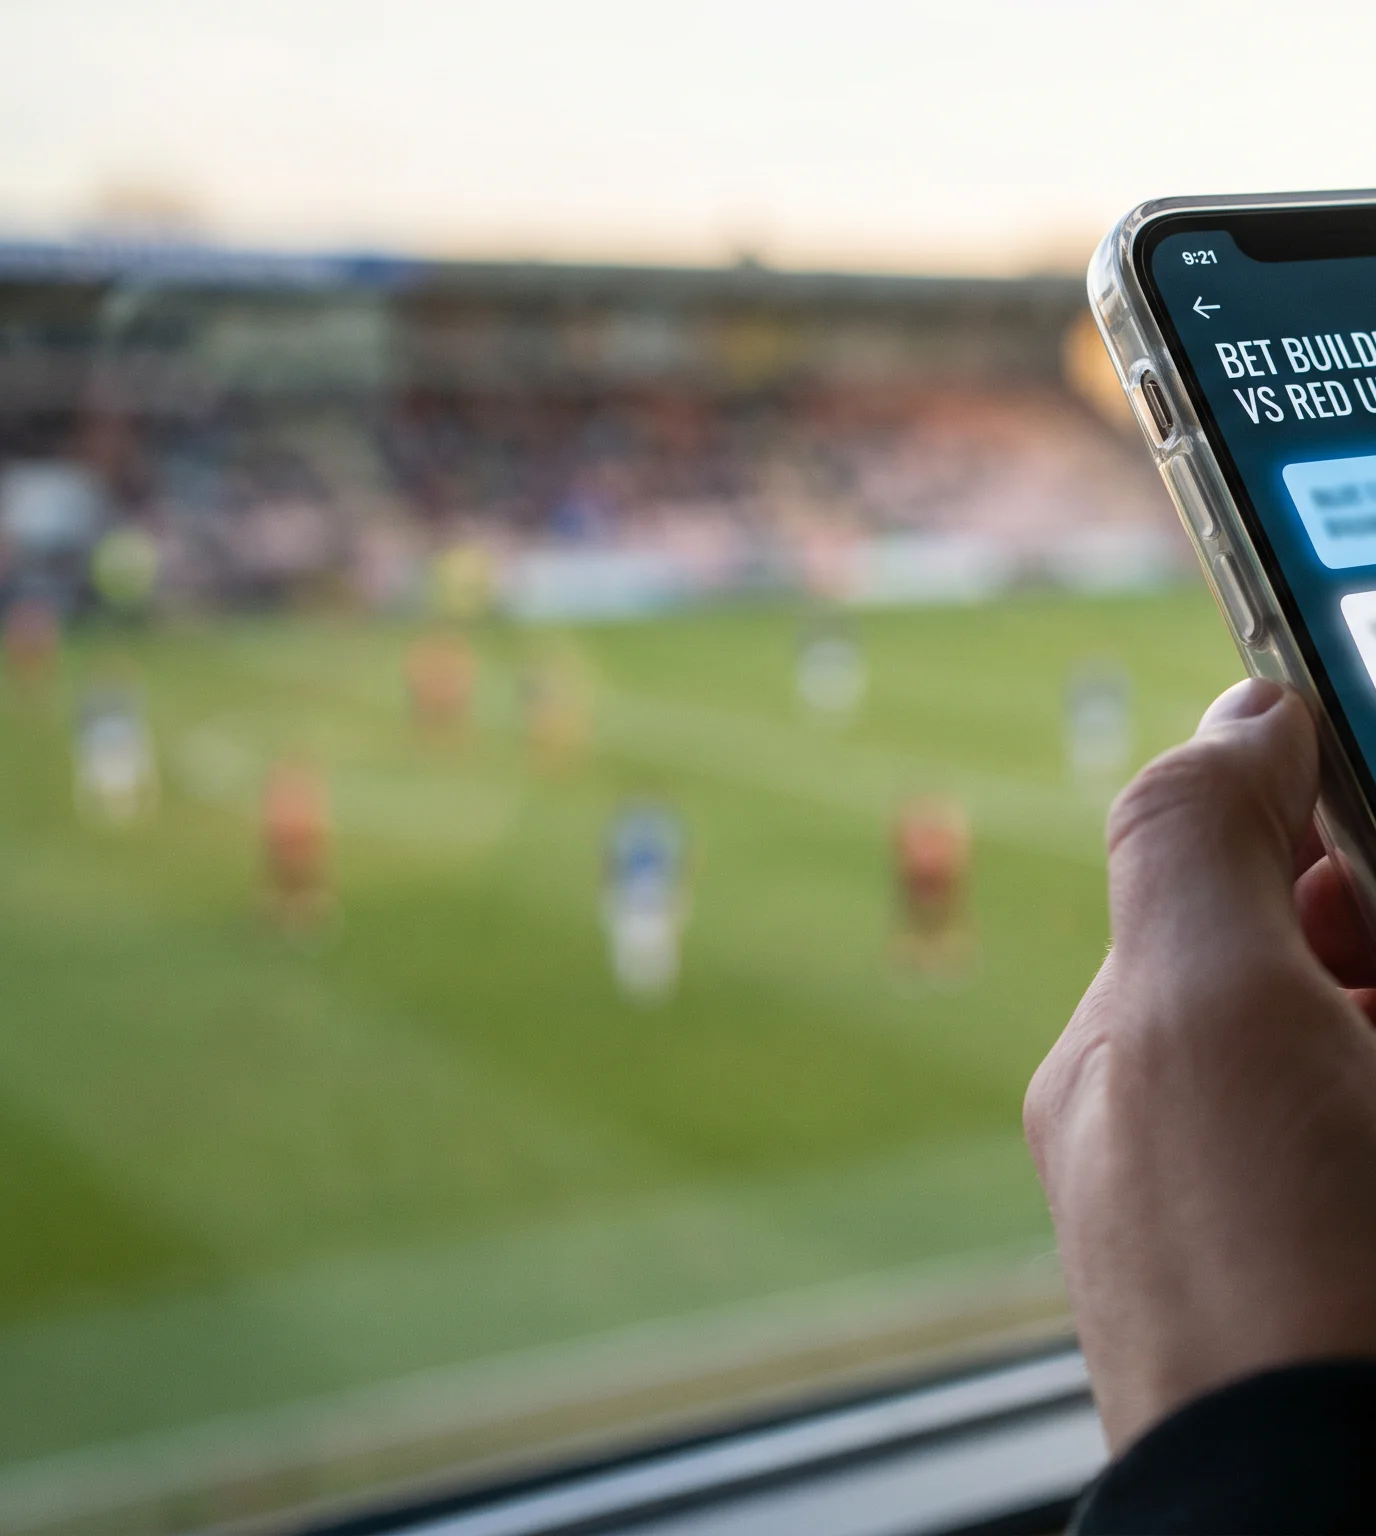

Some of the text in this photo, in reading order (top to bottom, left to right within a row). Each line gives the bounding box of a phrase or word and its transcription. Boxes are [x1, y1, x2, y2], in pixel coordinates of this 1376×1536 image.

[1181, 249, 1218, 266] 9:21
[1214, 339, 1279, 379] BET
[1232, 386, 1285, 425] VS
[1284, 380, 1353, 420] RED
